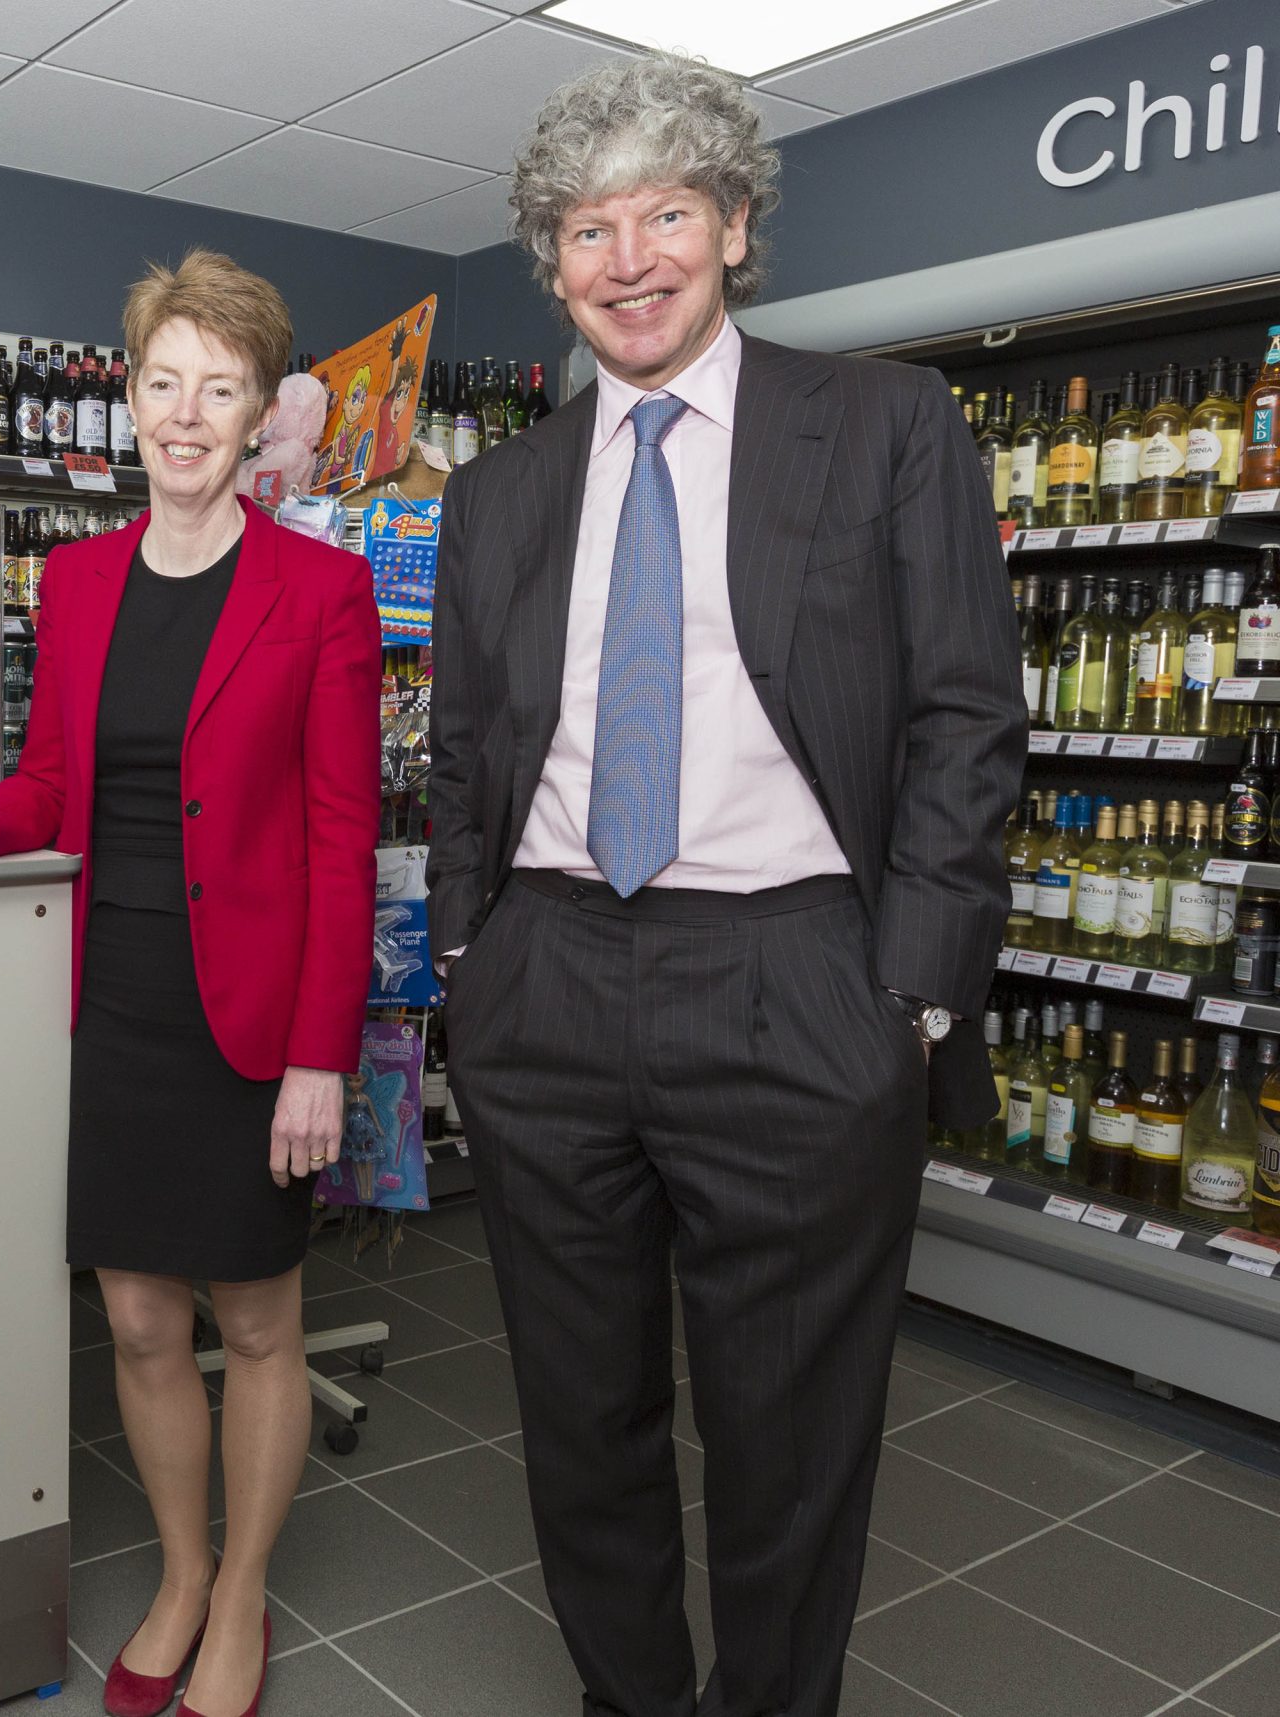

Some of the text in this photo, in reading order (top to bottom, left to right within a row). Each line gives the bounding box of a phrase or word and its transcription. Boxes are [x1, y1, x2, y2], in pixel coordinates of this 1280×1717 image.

[1037, 44, 1280, 188] Chil
[1255, 411, 1269, 440] WKD
[1092, 887, 1113, 896] FALLS
[1123, 891, 1144, 899] FALLS
[1179, 895, 1203, 904] ECHO
[390, 930, 427, 939] Passenger
[1194, 1169, 1242, 1188] Lambrini
